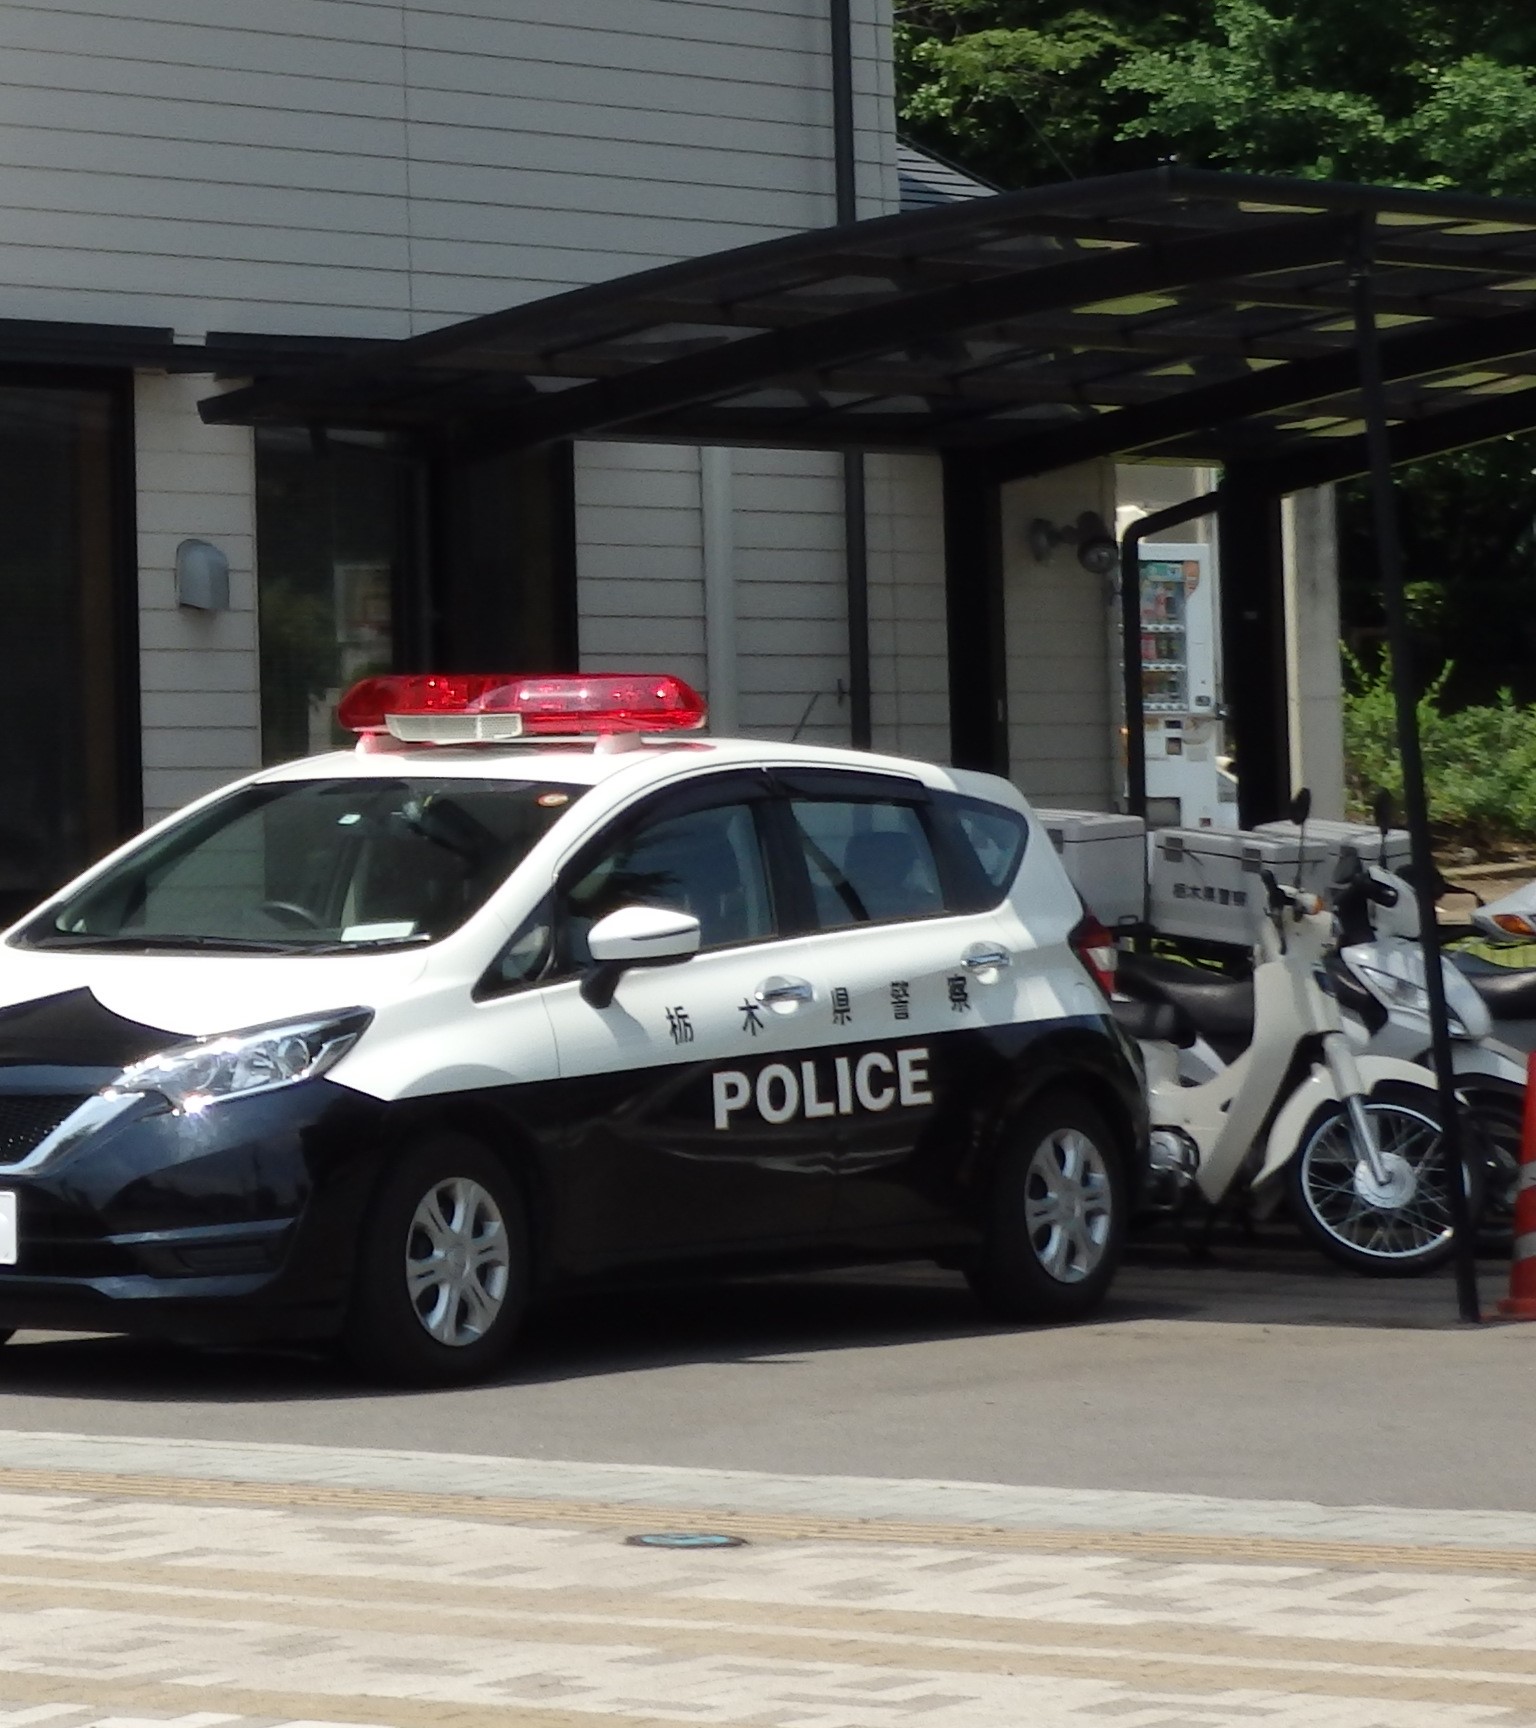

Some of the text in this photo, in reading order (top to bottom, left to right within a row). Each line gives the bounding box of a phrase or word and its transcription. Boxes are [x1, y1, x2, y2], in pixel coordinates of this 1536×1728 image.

[665, 974, 972, 1045] 栃木県警察
[712, 1047, 934, 1131] POLICE
